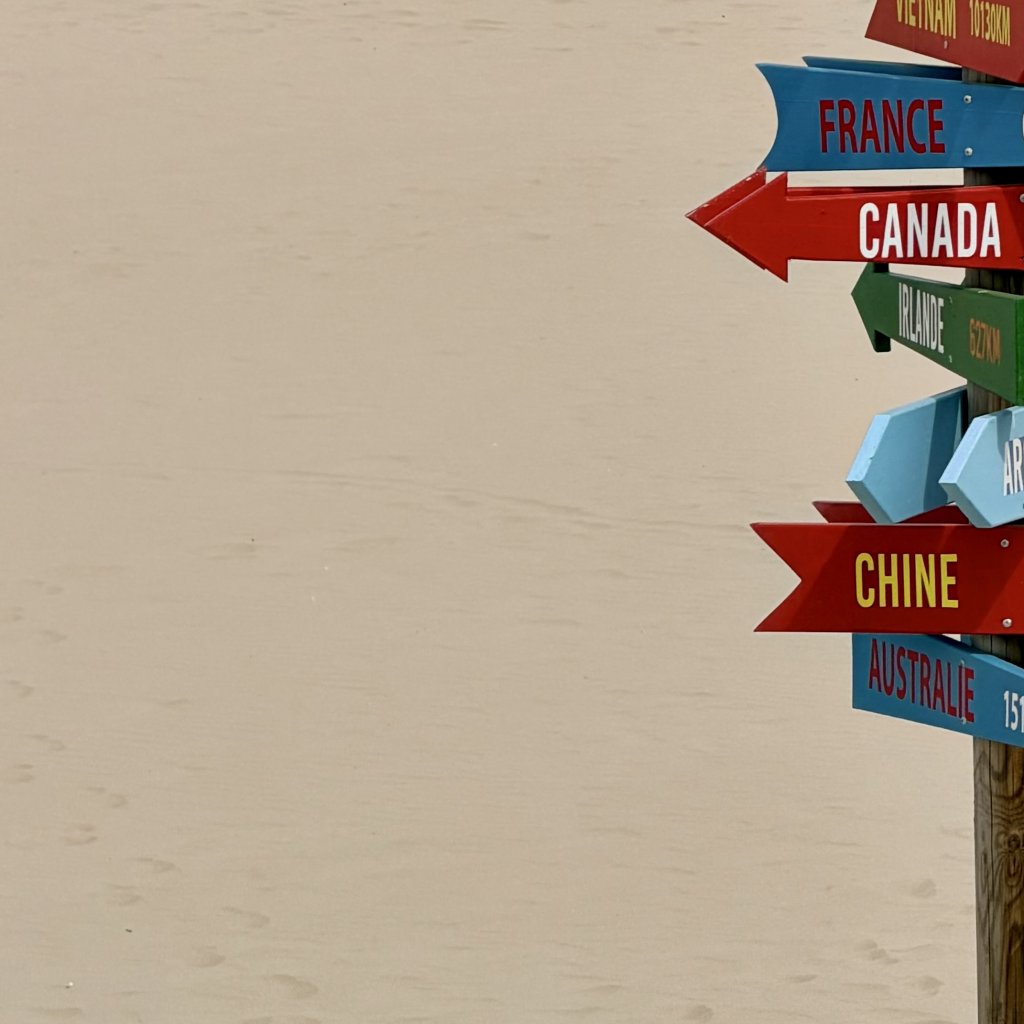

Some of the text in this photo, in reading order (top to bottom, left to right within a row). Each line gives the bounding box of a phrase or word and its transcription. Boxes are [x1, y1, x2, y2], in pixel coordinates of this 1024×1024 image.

[819, 99, 946, 154] FRANCE
[859, 202, 1001, 259] CANADA
[898, 282, 945, 354] IRLANDE
[855, 552, 959, 609] CHINE
[868, 638, 976, 723] AUSTRALIE
